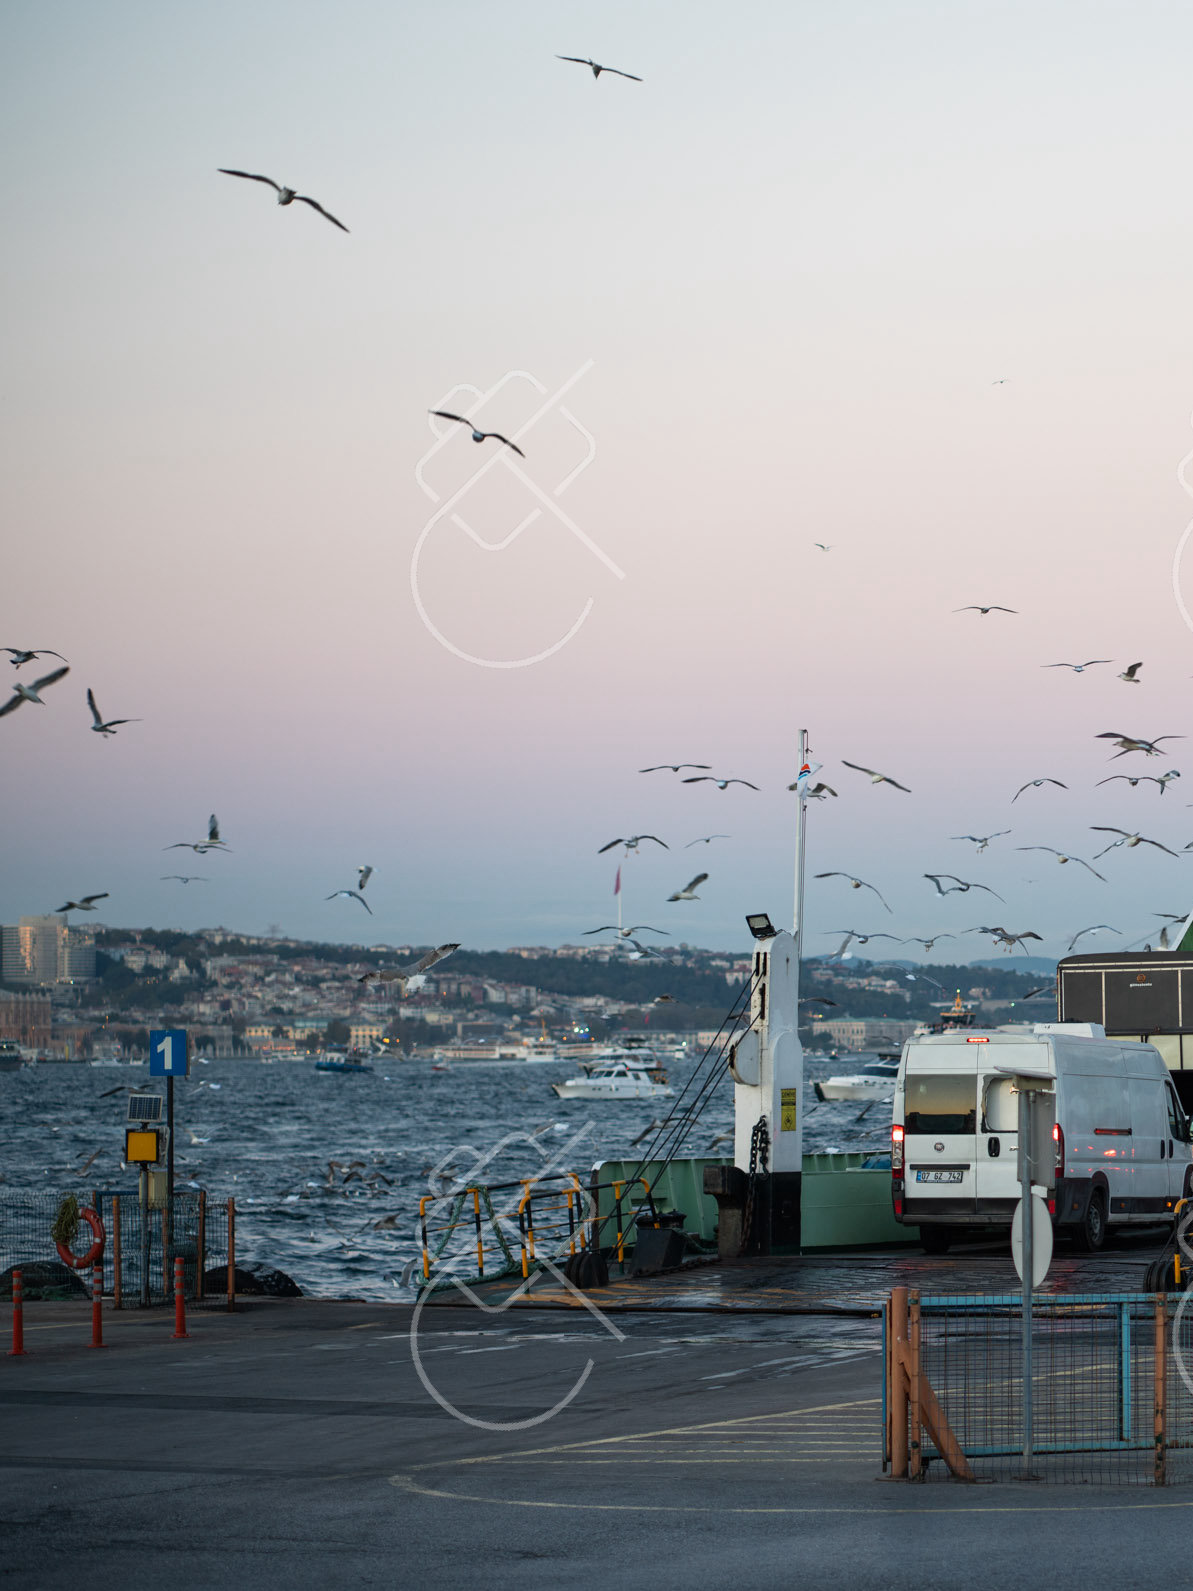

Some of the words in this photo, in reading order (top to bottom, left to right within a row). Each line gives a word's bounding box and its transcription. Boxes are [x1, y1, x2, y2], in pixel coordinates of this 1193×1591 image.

[157, 1036, 172, 1070] 1
[921, 1172, 930, 1180] 07
[948, 1172, 960, 1180] 742
